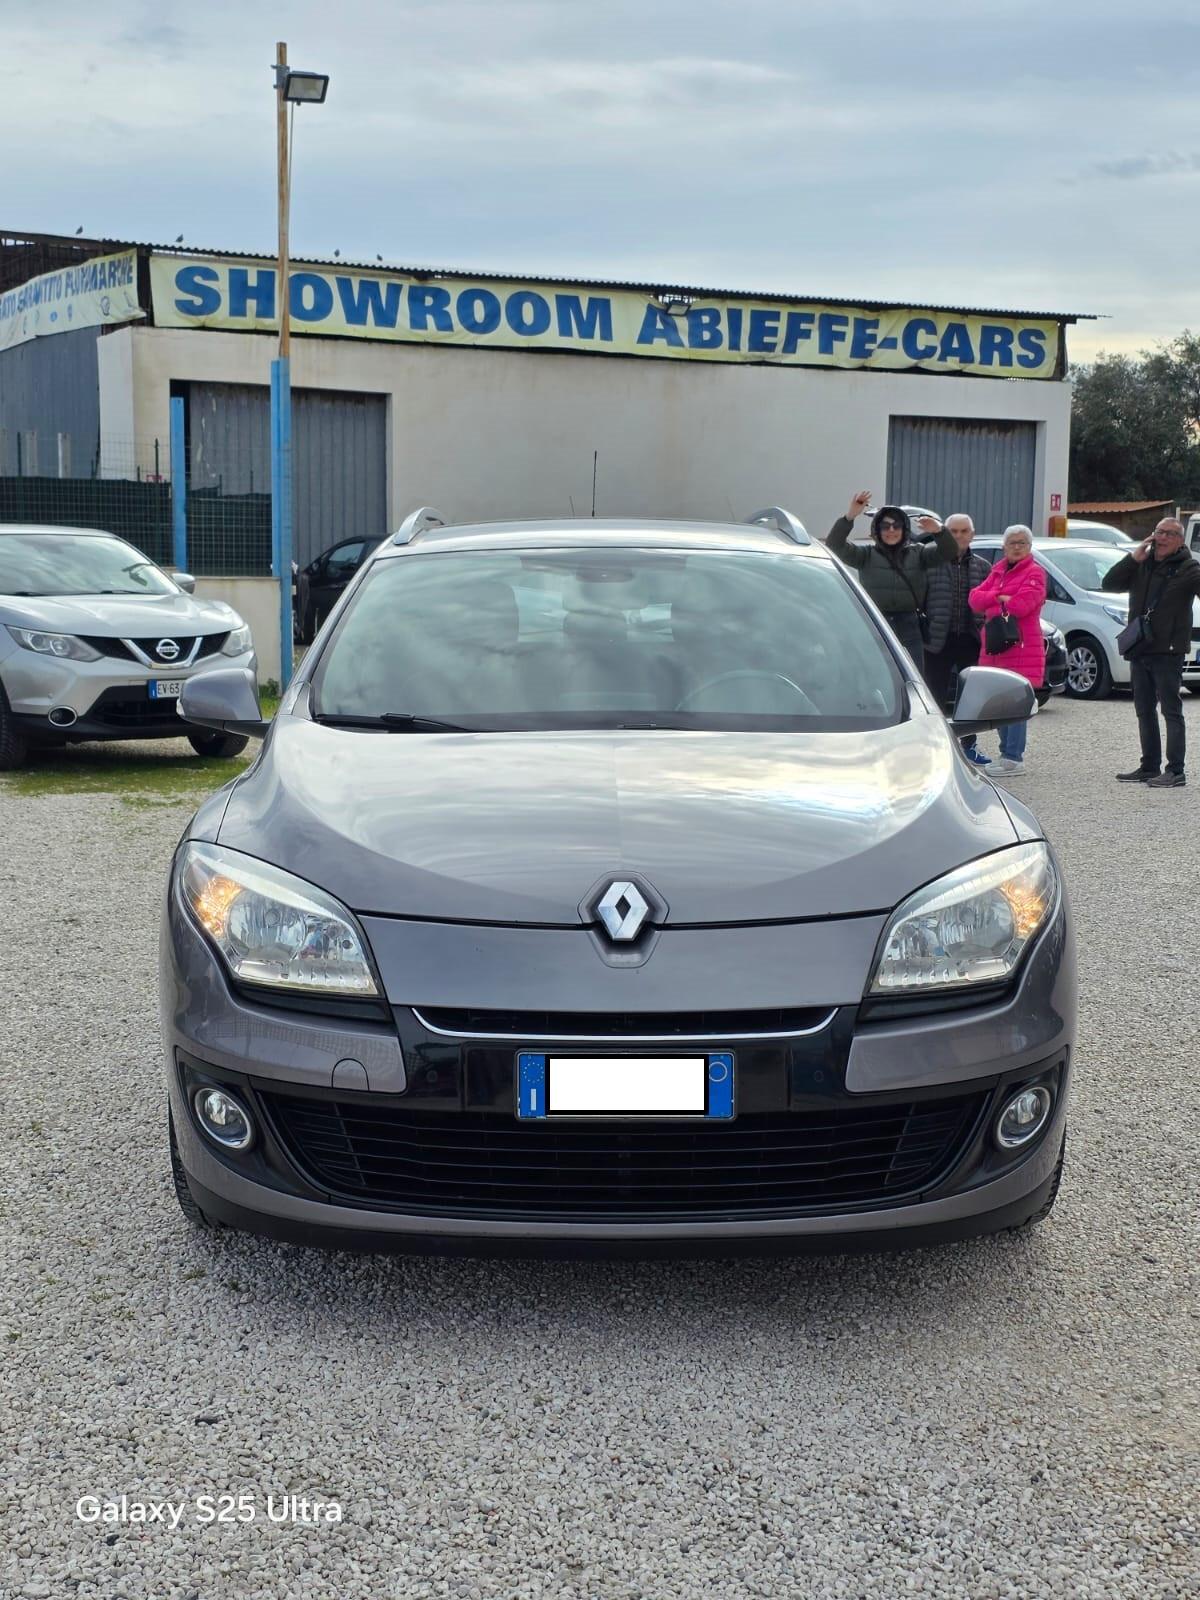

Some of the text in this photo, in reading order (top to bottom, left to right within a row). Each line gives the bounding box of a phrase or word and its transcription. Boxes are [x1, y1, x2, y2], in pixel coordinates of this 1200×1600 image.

[174, 266, 1046, 369] SHOWROOM ABIEFFE-CARS
[169, 683, 180, 694] 63
